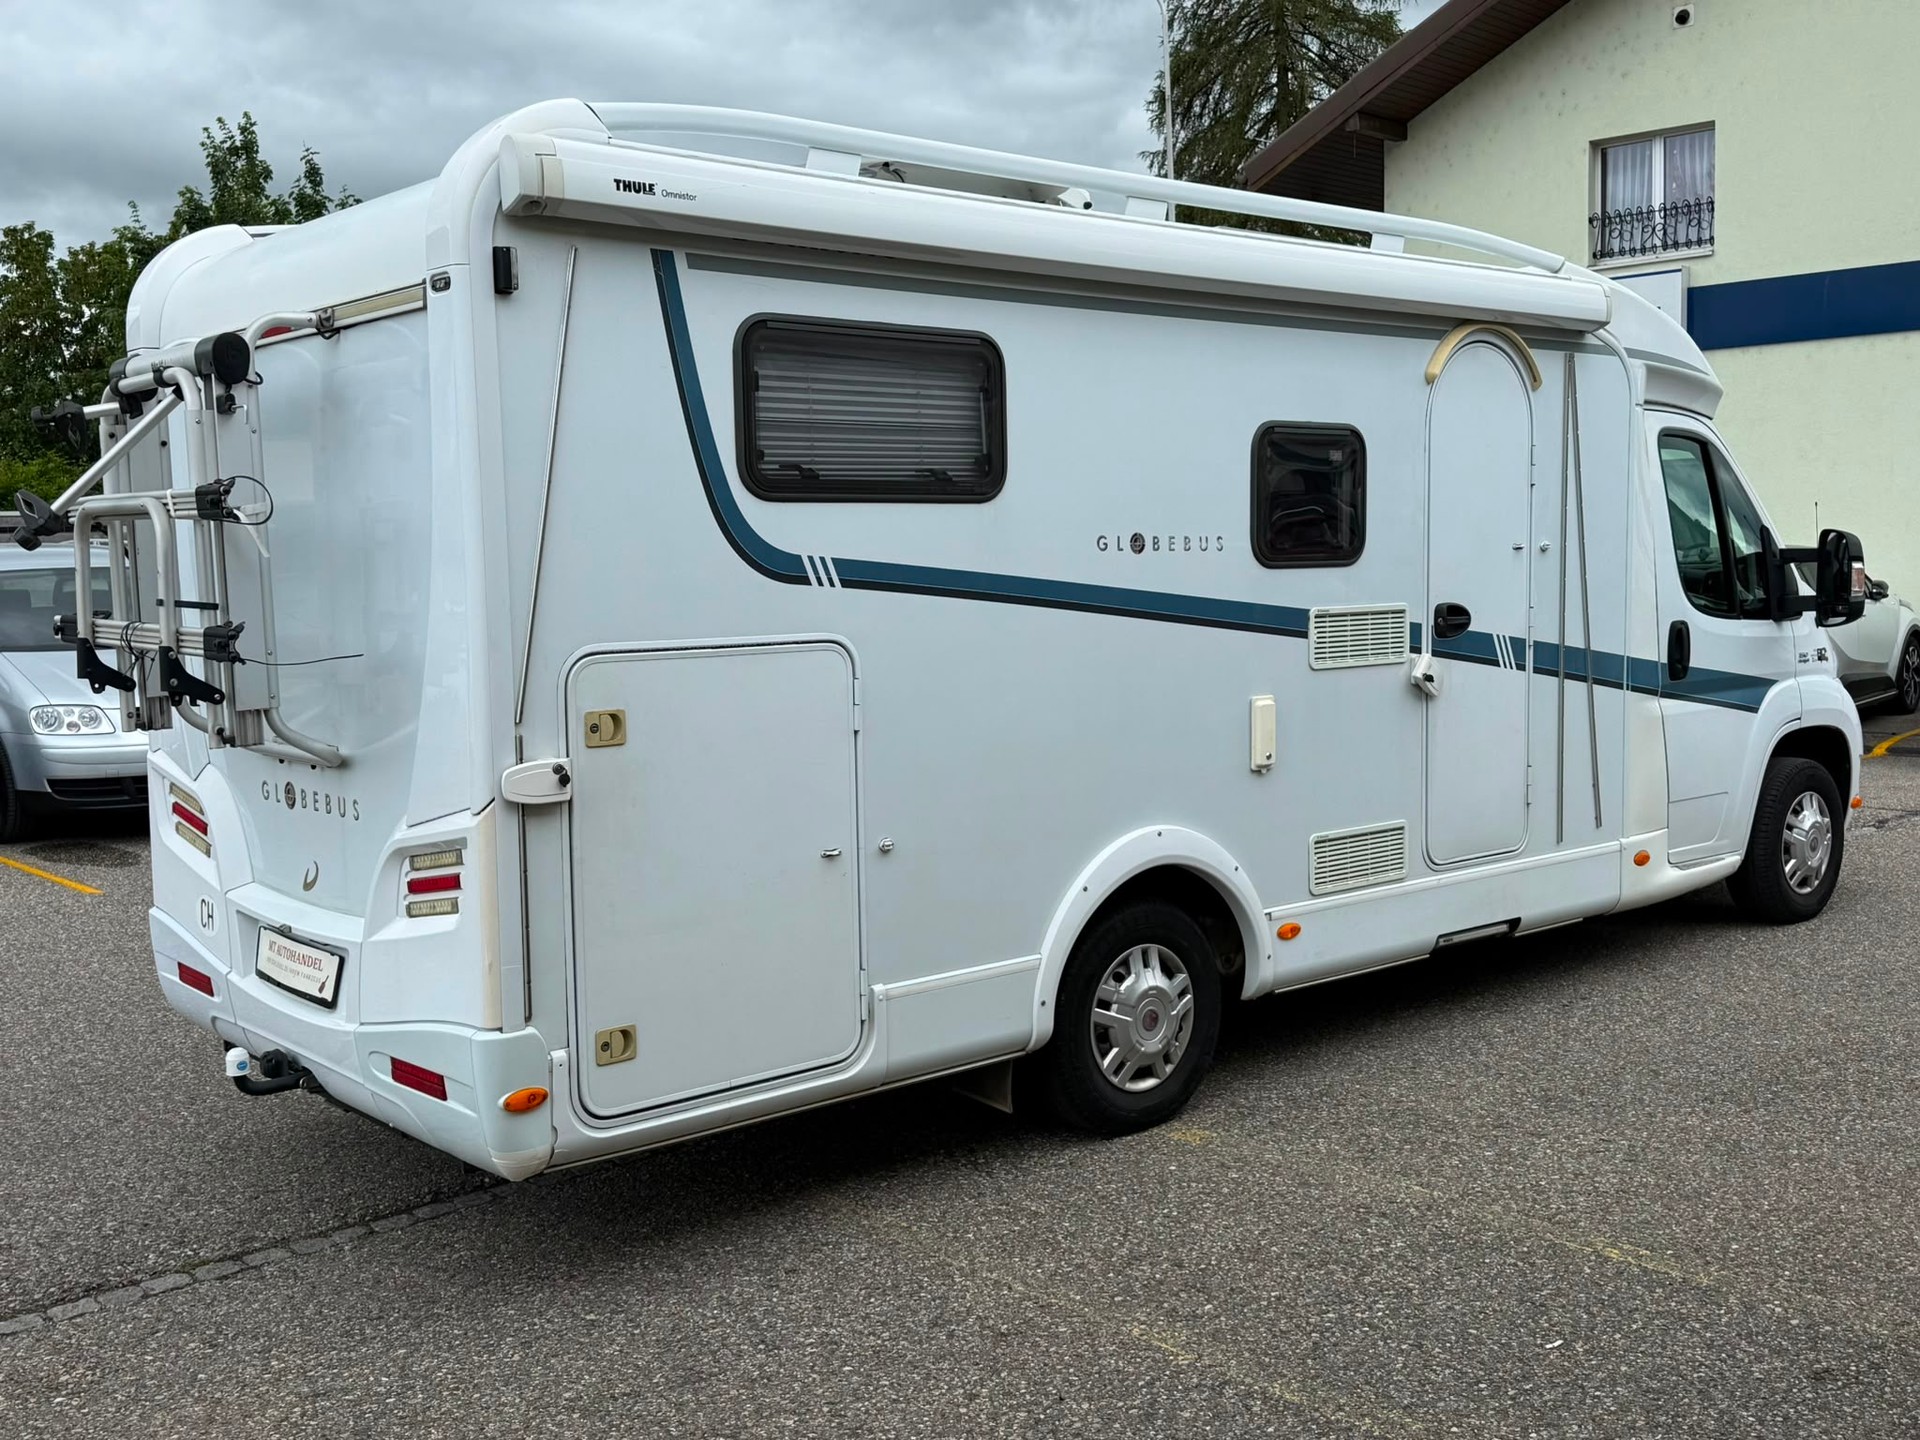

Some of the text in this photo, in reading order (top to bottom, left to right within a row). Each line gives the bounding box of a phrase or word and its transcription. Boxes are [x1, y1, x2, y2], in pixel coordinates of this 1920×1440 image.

[613, 178, 697, 201] THULE Omnistor
[1096, 532, 1224, 554] GLOBEBUS
[261, 780, 360, 821] GLOBEBUS
[200, 898, 214, 931] CH
[276, 944, 324, 972] AUTOHANDEL
